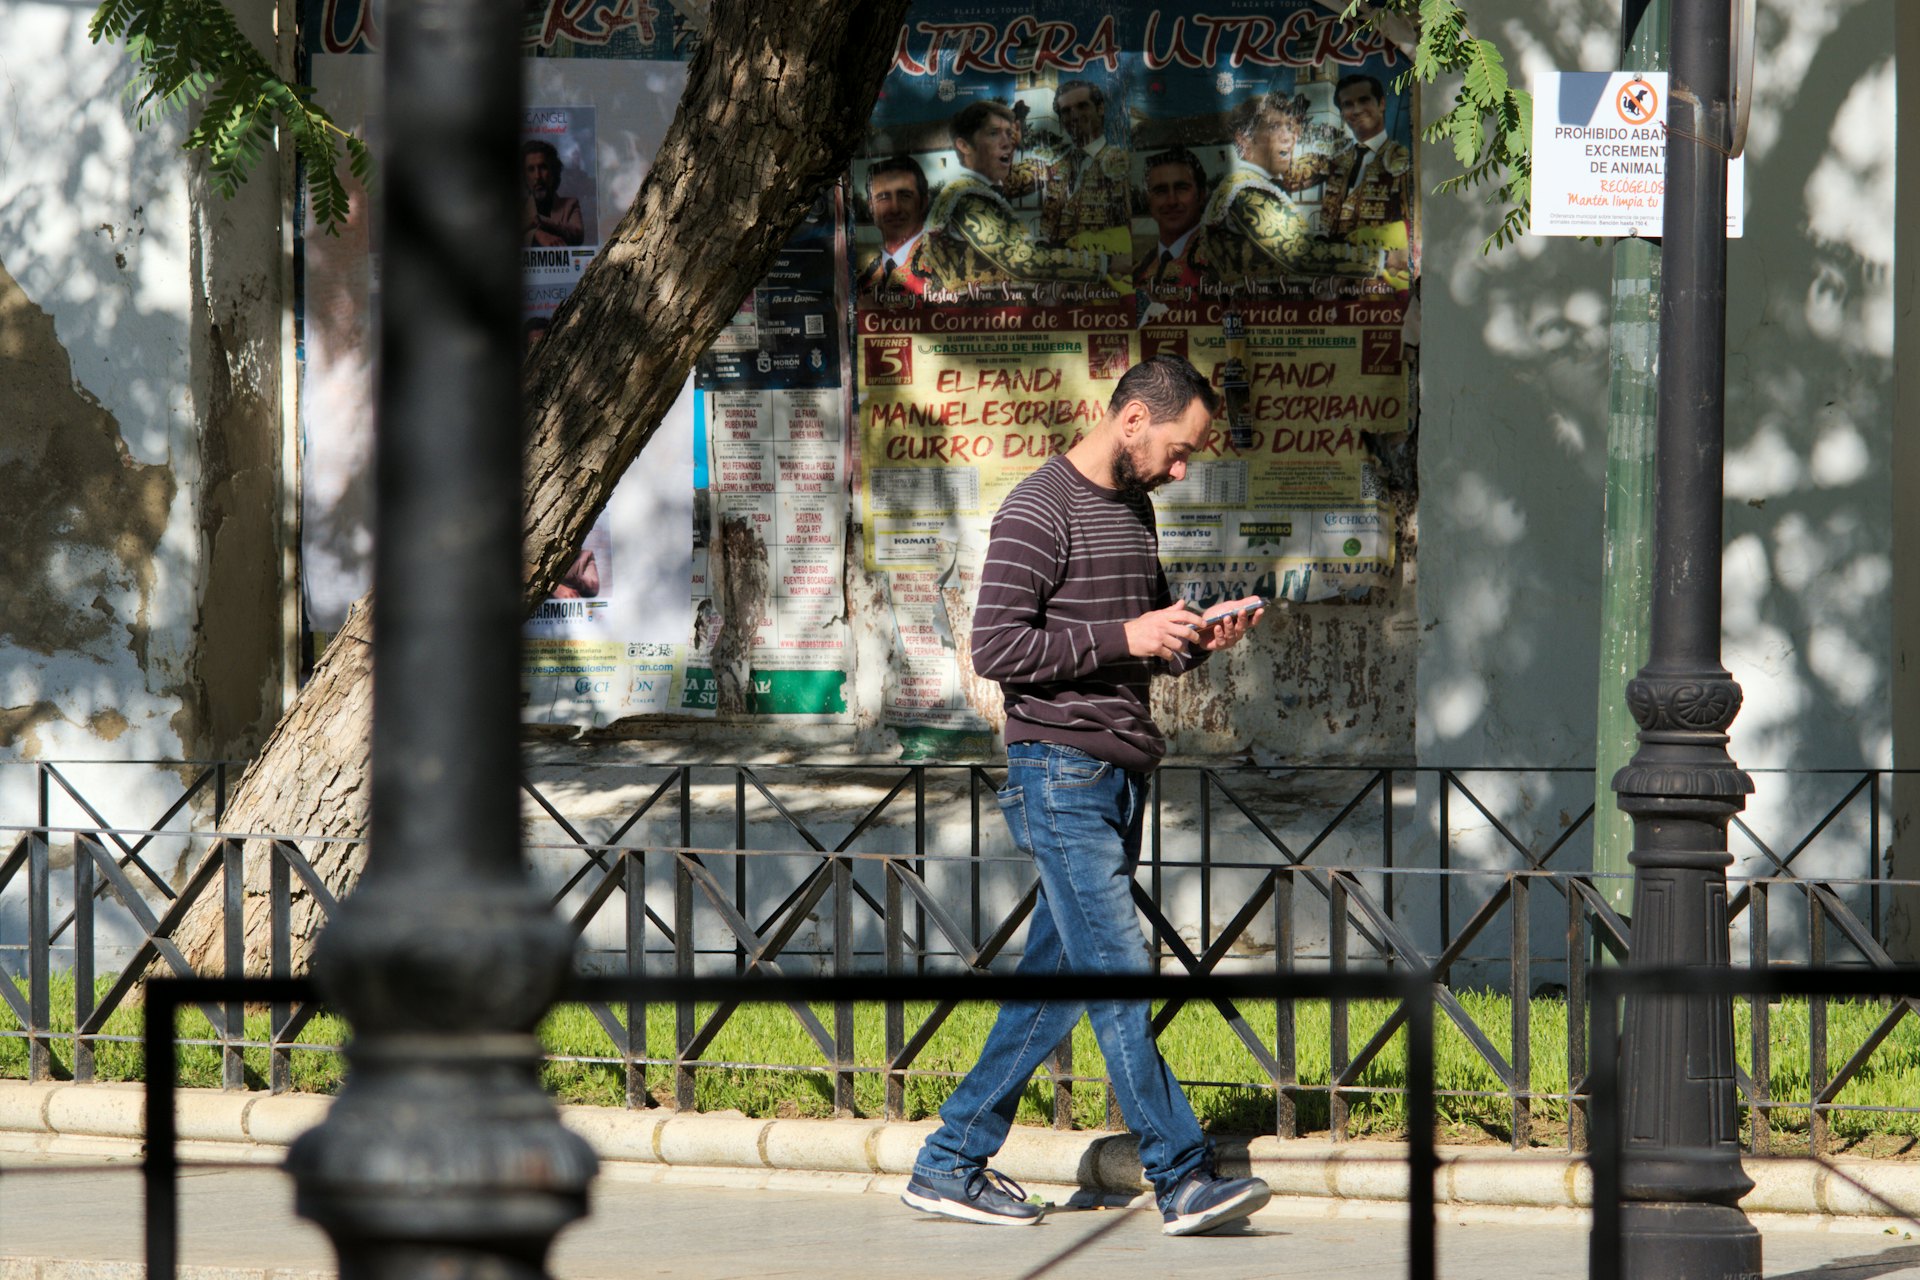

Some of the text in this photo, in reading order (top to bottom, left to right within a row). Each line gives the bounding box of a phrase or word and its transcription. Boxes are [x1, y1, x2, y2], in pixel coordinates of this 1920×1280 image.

[1144, 9, 1400, 70] UTRERA
[1555, 127, 1668, 141] PROHIBIDO ABAN
[1585, 145, 1667, 157] EXCREMENT
[1590, 162, 1665, 174] DE ANIMAL
[1567, 192, 1659, 211] Mantén limpia tu
[522, 251, 570, 267] ARMONA
[921, 282, 961, 304] Fiestas
[1031, 285, 1047, 301] de
[1308, 303, 1337, 323] de
[1346, 303, 1402, 323] Toros
[864, 308, 1129, 332] Gran Corrida de Toros
[1145, 330, 1185, 340] VIERNES
[1369, 331, 1393, 341] A LAS
[868, 338, 909, 348] VIERNES
[1209, 336, 1357, 346] CALLEJO DE HUEBRA
[933, 341, 1083, 353] CASTILLEJO DE HUEBRA
[1371, 343, 1392, 365] 7
[879, 347, 903, 377] 5
[936, 367, 1062, 394] EL FANDI
[1250, 362, 1336, 389] FANDI
[725, 409, 741, 418] CURRO
[795, 409, 818, 418] EL FANDI
[1255, 394, 1400, 423] ESCRIBANO
[871, 400, 979, 430] MANUEL
[741, 420, 758, 429] PINAR
[789, 419, 804, 428] DAVID
[886, 433, 994, 465] CURRO
[732, 461, 762, 471] FERNANDES
[780, 461, 804, 471] MORANTE
[816, 461, 835, 471] PUEBLA
[723, 472, 762, 481] DIEGO VENTURA
[801, 472, 835, 482] MANZANARES
[751, 483, 775, 492] MENDOZA
[795, 482, 822, 492] TALAVANTE
[795, 512, 822, 523] CAYETANO
[1339, 512, 1380, 525] CHICÓN
[796, 524, 822, 534] ROCA REY
[1162, 528, 1211, 538] KOMATSU
[786, 534, 831, 544] DAVID MIRANDA
[894, 536, 937, 545] KOMATS
[793, 565, 828, 574] DIEGO BASTOS
[783, 576, 836, 585] FUENTES BOCANEGRA
[896, 572, 918, 581] MANUEL
[892, 583, 913, 592] MIGUEL
[903, 594, 919, 603] BORJA
[905, 636, 939, 645] PEPE MORAL
[901, 688, 917, 697] FABIO
[895, 697, 918, 707] CRISTIAN
